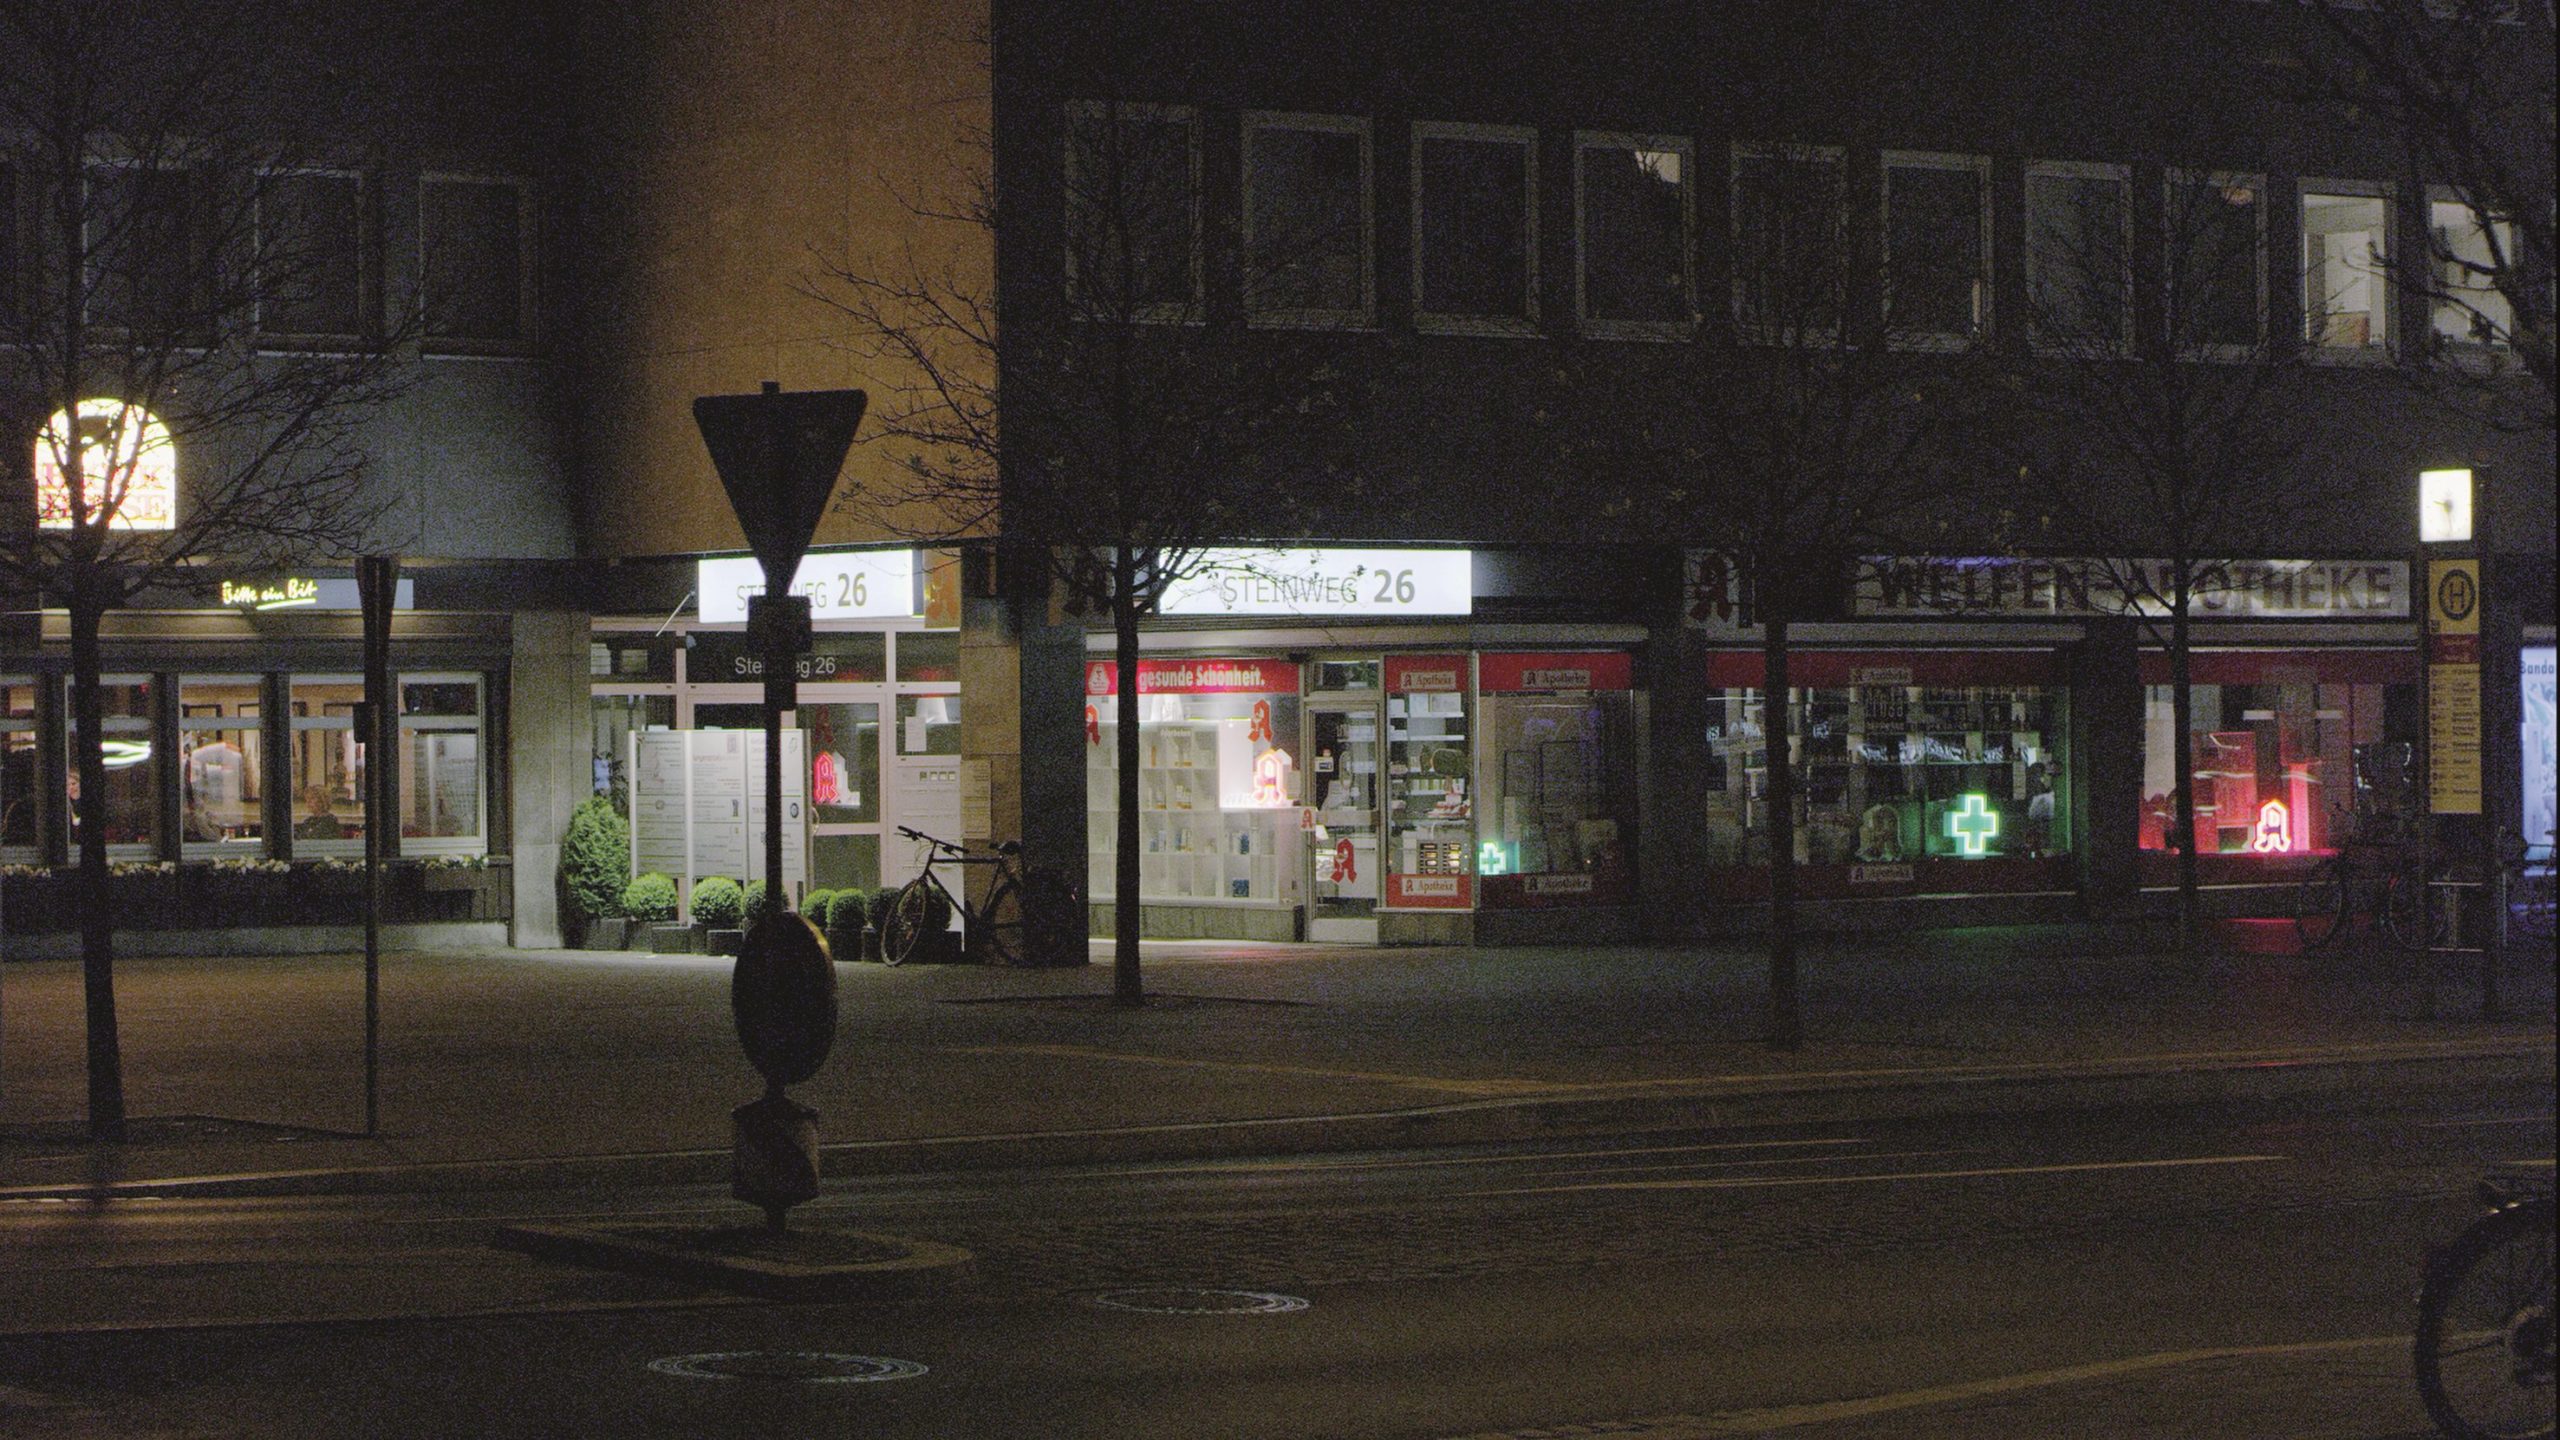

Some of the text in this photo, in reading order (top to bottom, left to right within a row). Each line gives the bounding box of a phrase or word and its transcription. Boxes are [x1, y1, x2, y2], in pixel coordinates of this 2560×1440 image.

[261, 586, 285, 601] ein
[287, 577, 318, 599] Bit
[736, 572, 867, 612] STEG 26
[1222, 568, 1416, 604] STEINWEG 26
[735, 656, 836, 678] Steg 26
[1139, 664, 1266, 691] gesunde Schönheit.
